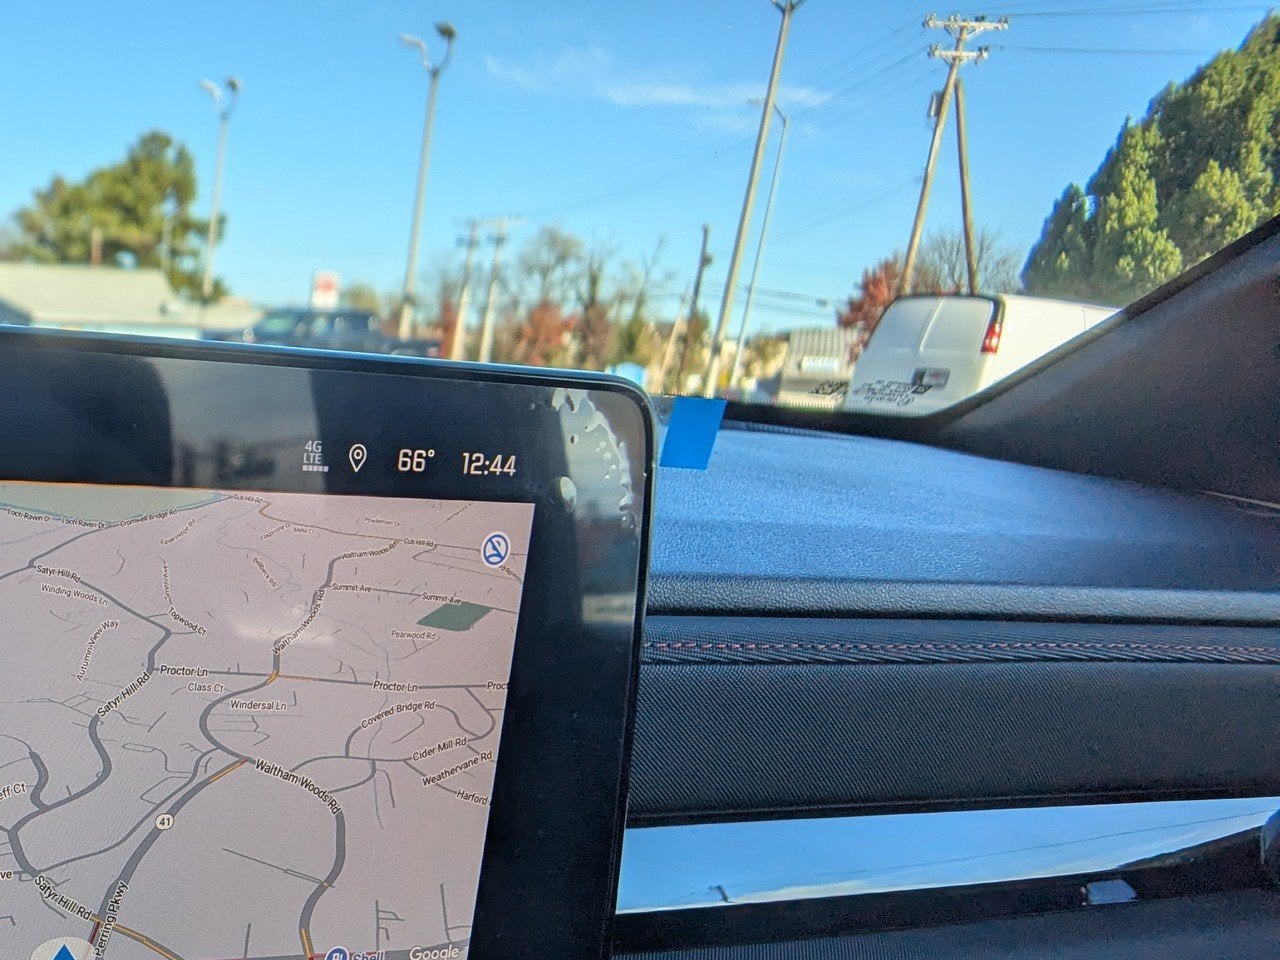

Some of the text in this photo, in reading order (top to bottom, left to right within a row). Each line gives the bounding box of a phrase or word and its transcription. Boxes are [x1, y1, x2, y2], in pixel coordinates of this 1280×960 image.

[304, 440, 322, 452] 4G
[303, 453, 322, 464] LTE
[398, 448, 435, 472] 66°
[462, 452, 516, 476] 12:44
[24, 511, 43, 522] Raven
[37, 565, 82, 583] Satyr Hill Rd
[41, 583, 108, 606] Winding Woods Ln
[332, 582, 372, 593] Summit Ave
[422, 593, 461, 605] Summit Ave
[167, 606, 207, 636] Topwood Ct
[273, 589, 325, 655] Waltham Woods Rd
[391, 629, 436, 640] Pearwood Rd
[76, 619, 120, 681] Autumn View Way
[159, 665, 208, 677] Proctor Ln
[97, 671, 151, 718] Satyr Hill Rd
[188, 682, 224, 693] Class Ct
[373, 680, 418, 692] Proctor Ln
[231, 699, 287, 710] Windersal Ln
[361, 700, 436, 729] Covered Bridge Rd
[412, 737, 467, 761] Cider Mill Rd
[422, 750, 493, 786] Weathervane Rd
[13, 782, 27, 795] Ct
[255, 758, 342, 815] Waltham Woods Rd
[457, 789, 488, 805] Harford
[158, 816, 172, 827] 41
[35, 875, 93, 921] Satyr Hill Rd
[94, 881, 129, 957] Perring Pkwy
